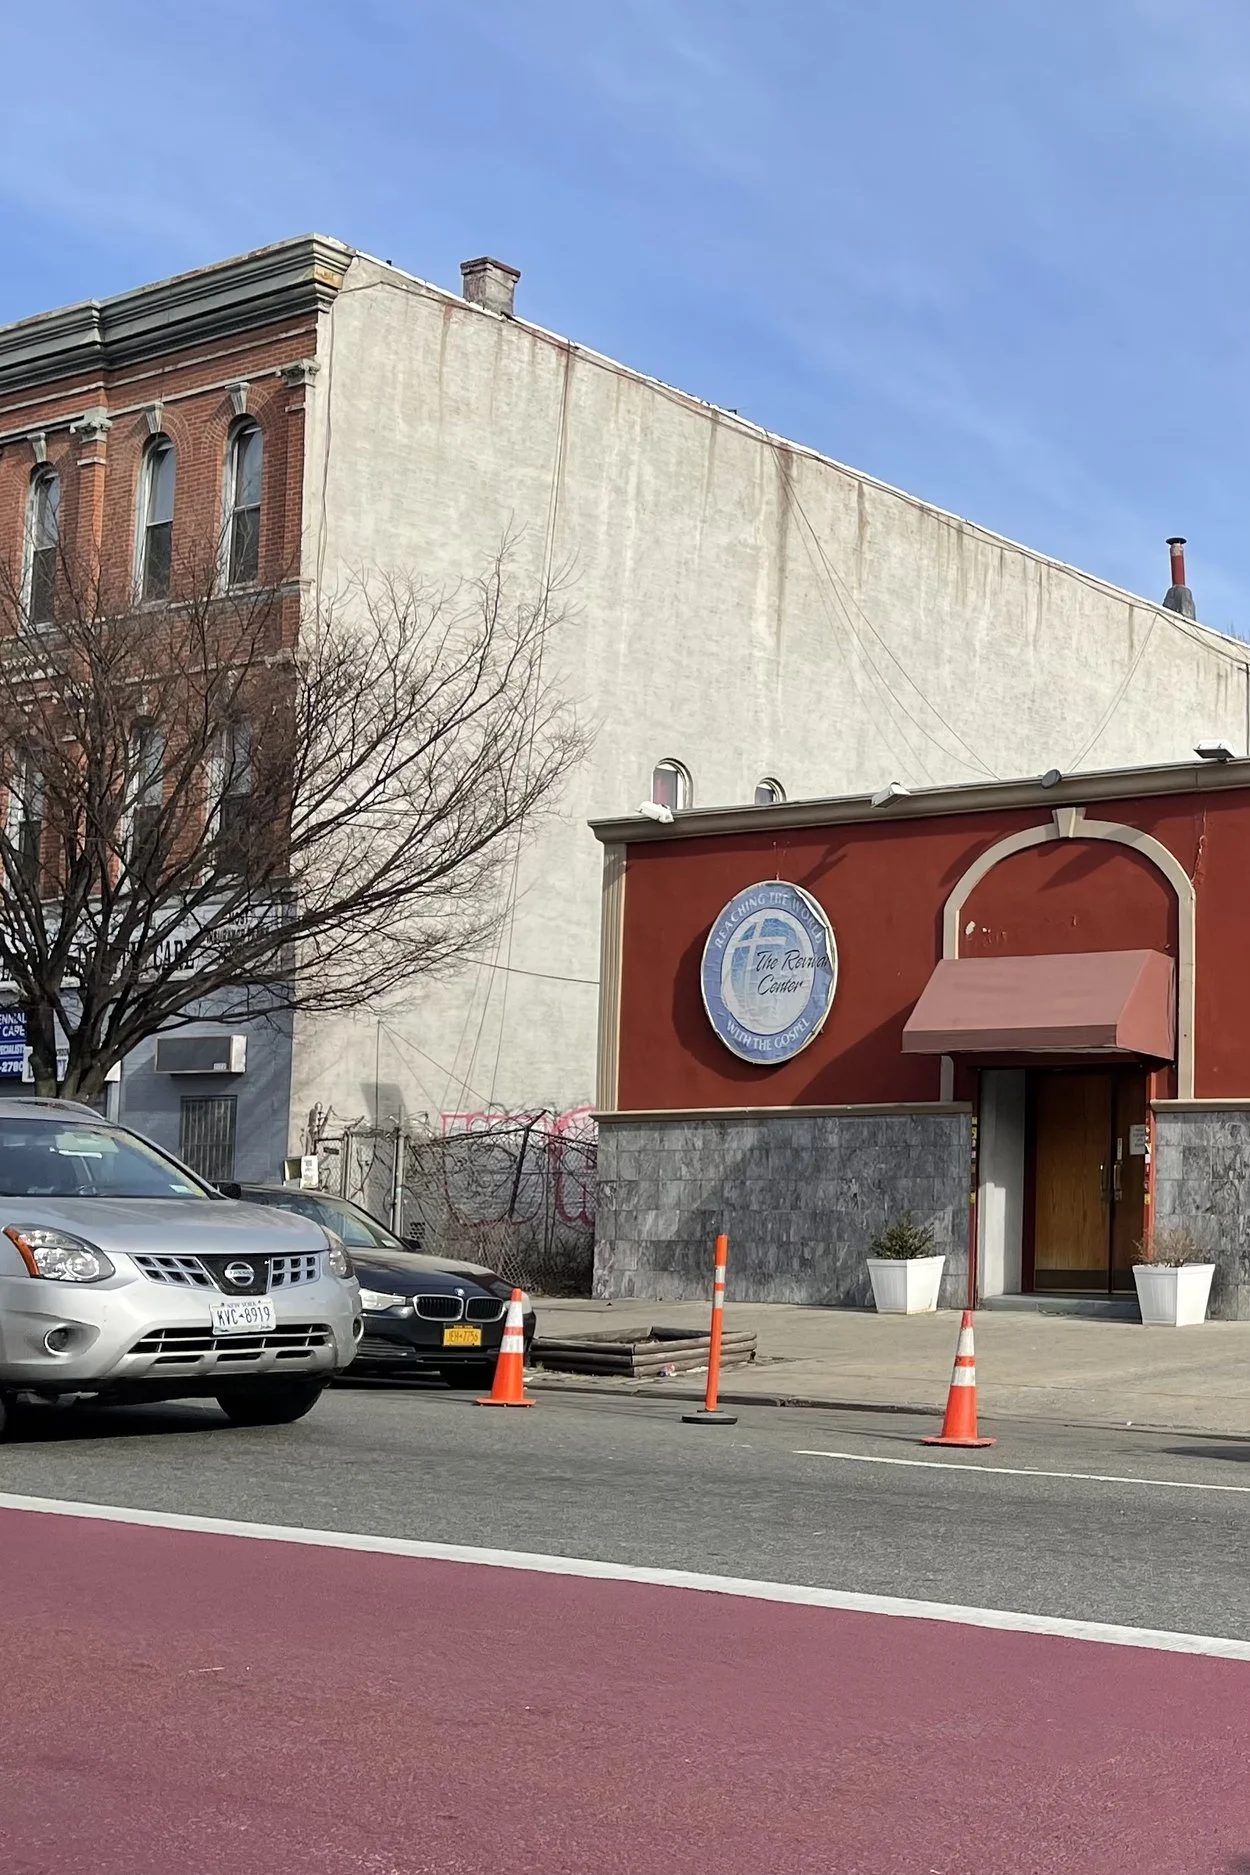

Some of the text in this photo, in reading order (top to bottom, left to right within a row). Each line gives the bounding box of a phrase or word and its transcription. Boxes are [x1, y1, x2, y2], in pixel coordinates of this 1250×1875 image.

[714, 891, 825, 949] REACHING THE WORLD
[756, 950, 779, 972] The
[757, 973, 804, 996] Center
[726, 1017, 810, 1051] WITH THE GOSPEL
